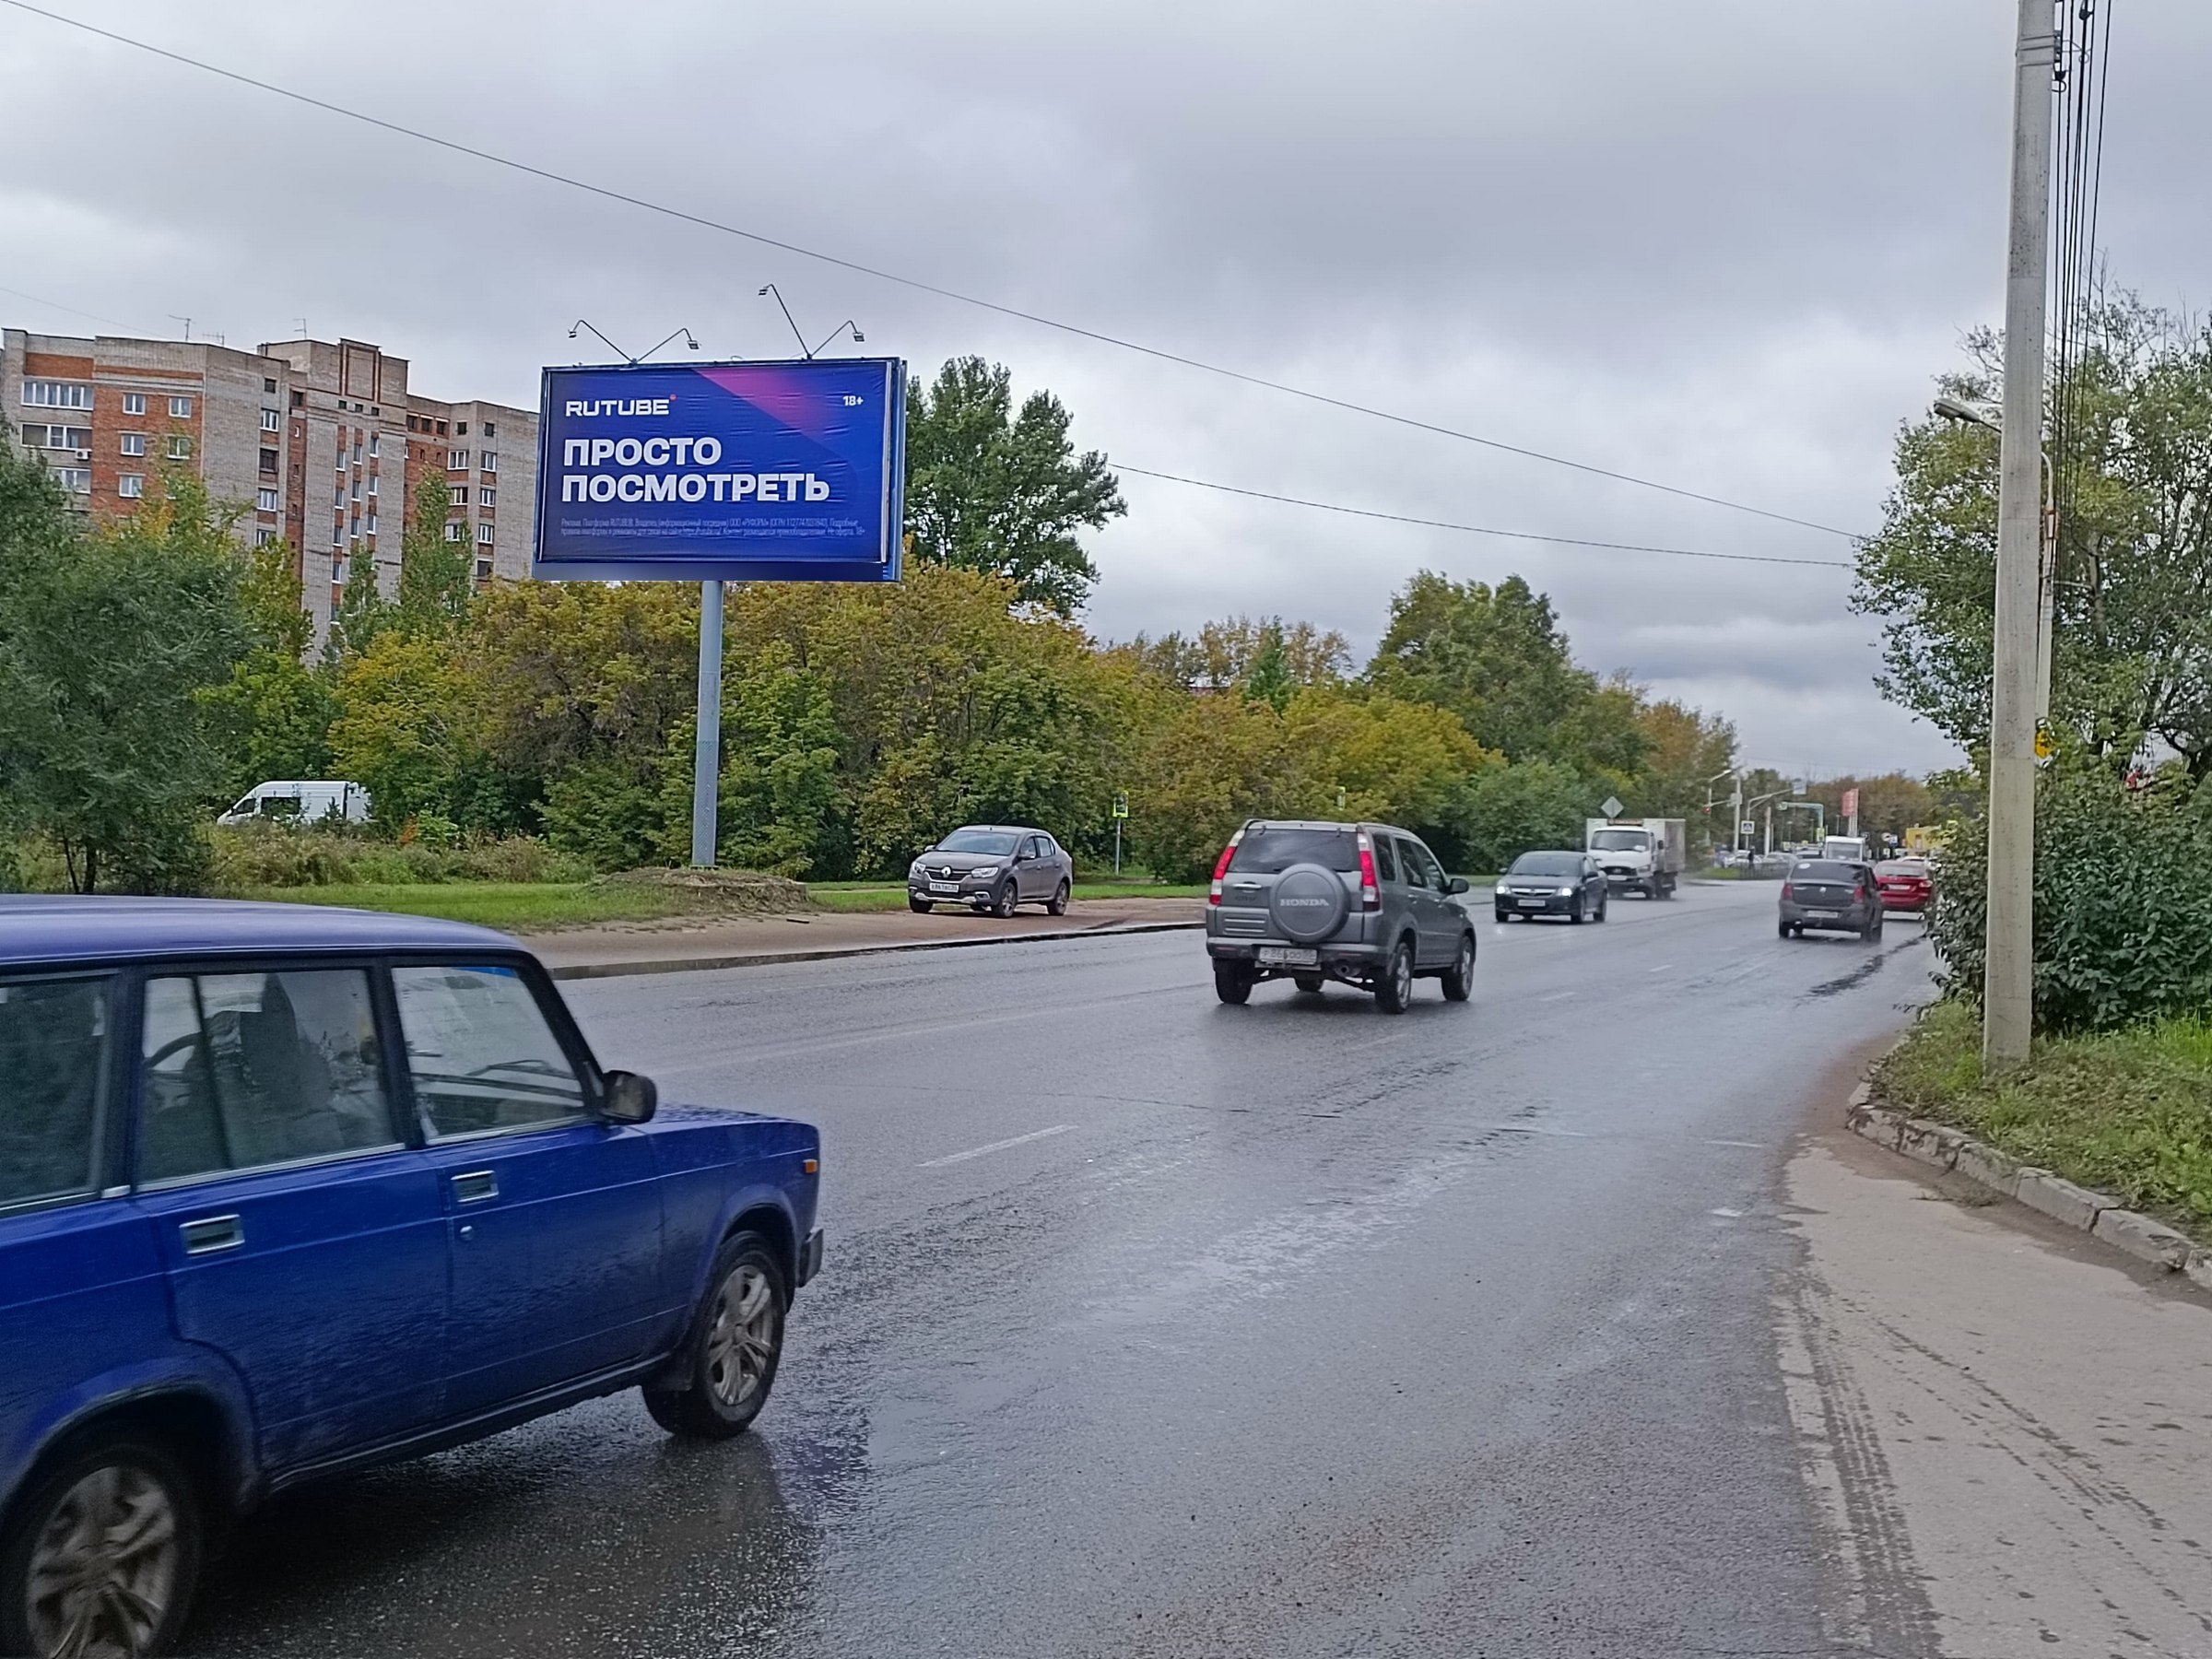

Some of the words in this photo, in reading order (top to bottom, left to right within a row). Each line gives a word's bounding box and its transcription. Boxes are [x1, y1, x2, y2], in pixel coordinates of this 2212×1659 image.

[565, 399, 670, 417] RUTUBE
[842, 394, 864, 406] 18+
[563, 437, 723, 466] ПРОСТО
[561, 473, 830, 502] ПОСМОТРЕТЬ
